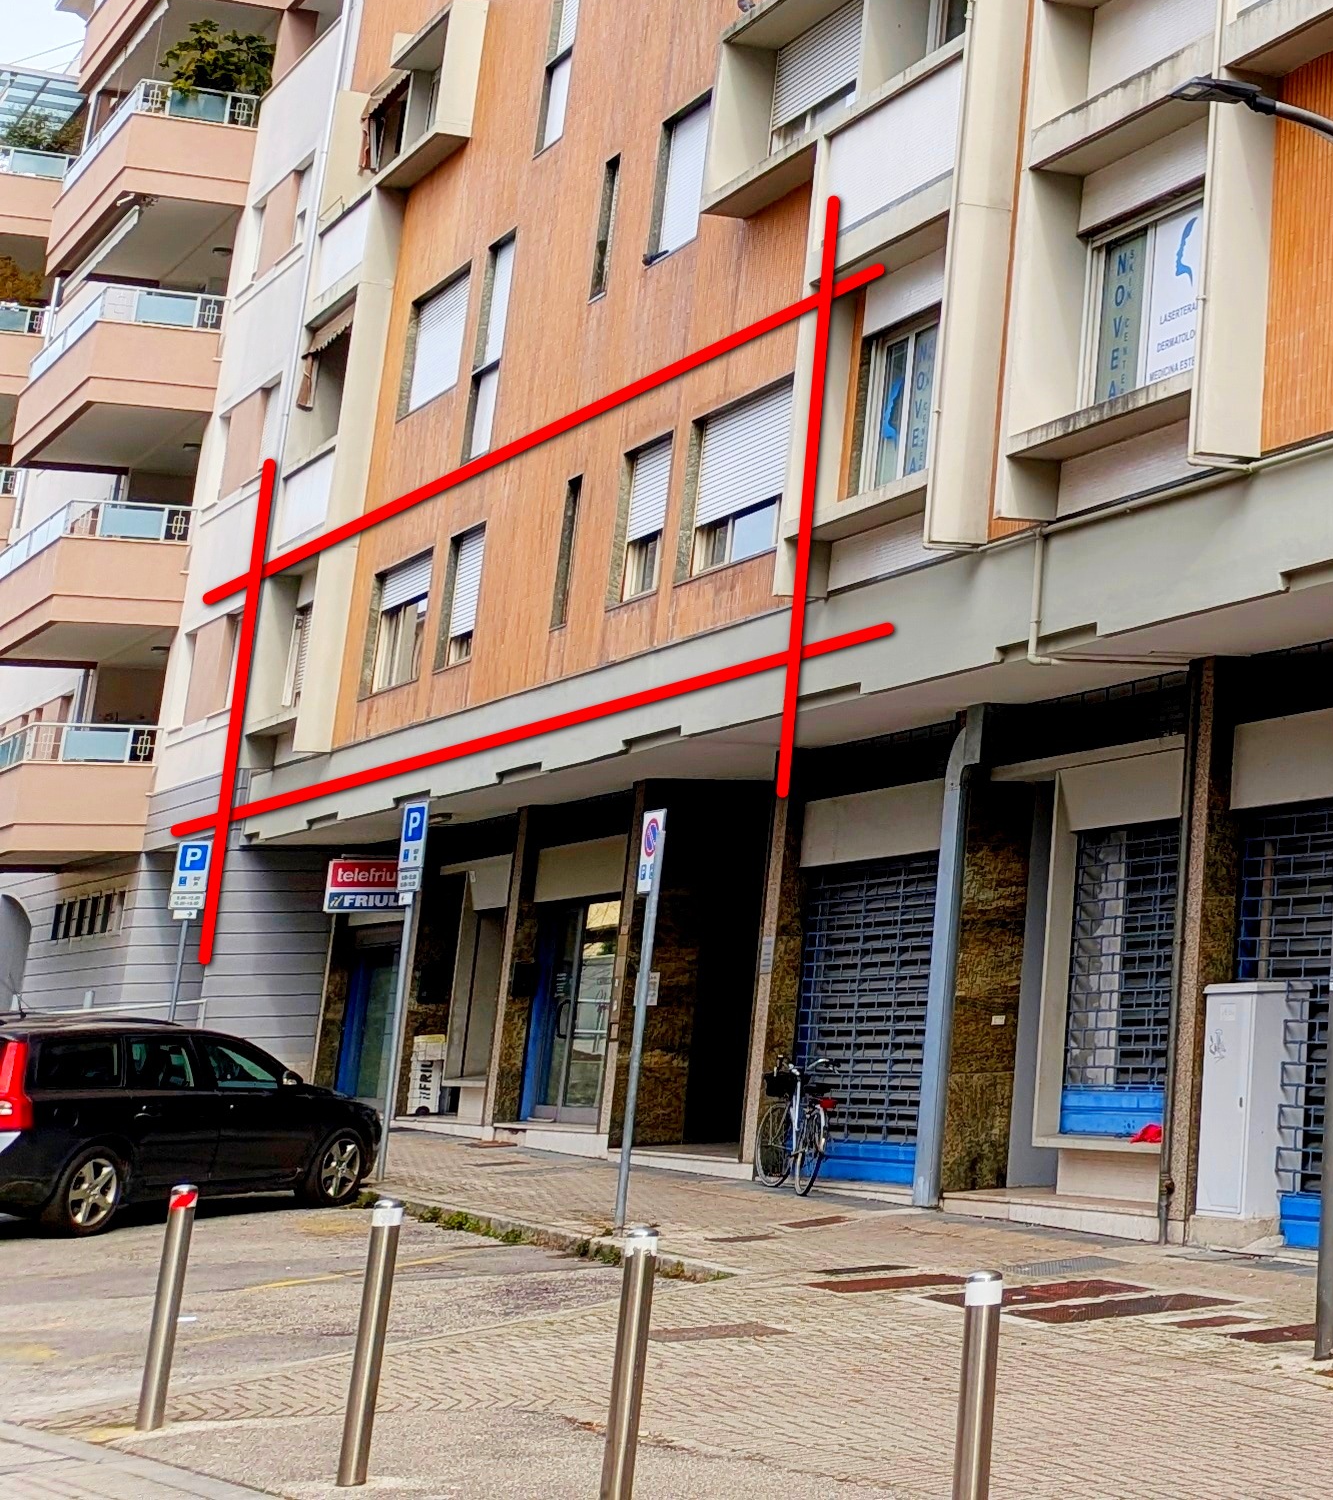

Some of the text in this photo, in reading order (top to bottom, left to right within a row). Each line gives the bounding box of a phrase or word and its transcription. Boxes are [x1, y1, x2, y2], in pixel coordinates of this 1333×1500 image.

[1108, 252, 1127, 399] NOVEA
[1159, 302, 1199, 325] LASERTERA
[1156, 328, 1197, 353] DERMATOLO
[1150, 356, 1196, 382] MEDICINA ESTE
[408, 812, 421, 837] P
[185, 847, 202, 868] P
[336, 867, 397, 883] telefriu
[343, 894, 400, 907] FRIUL
